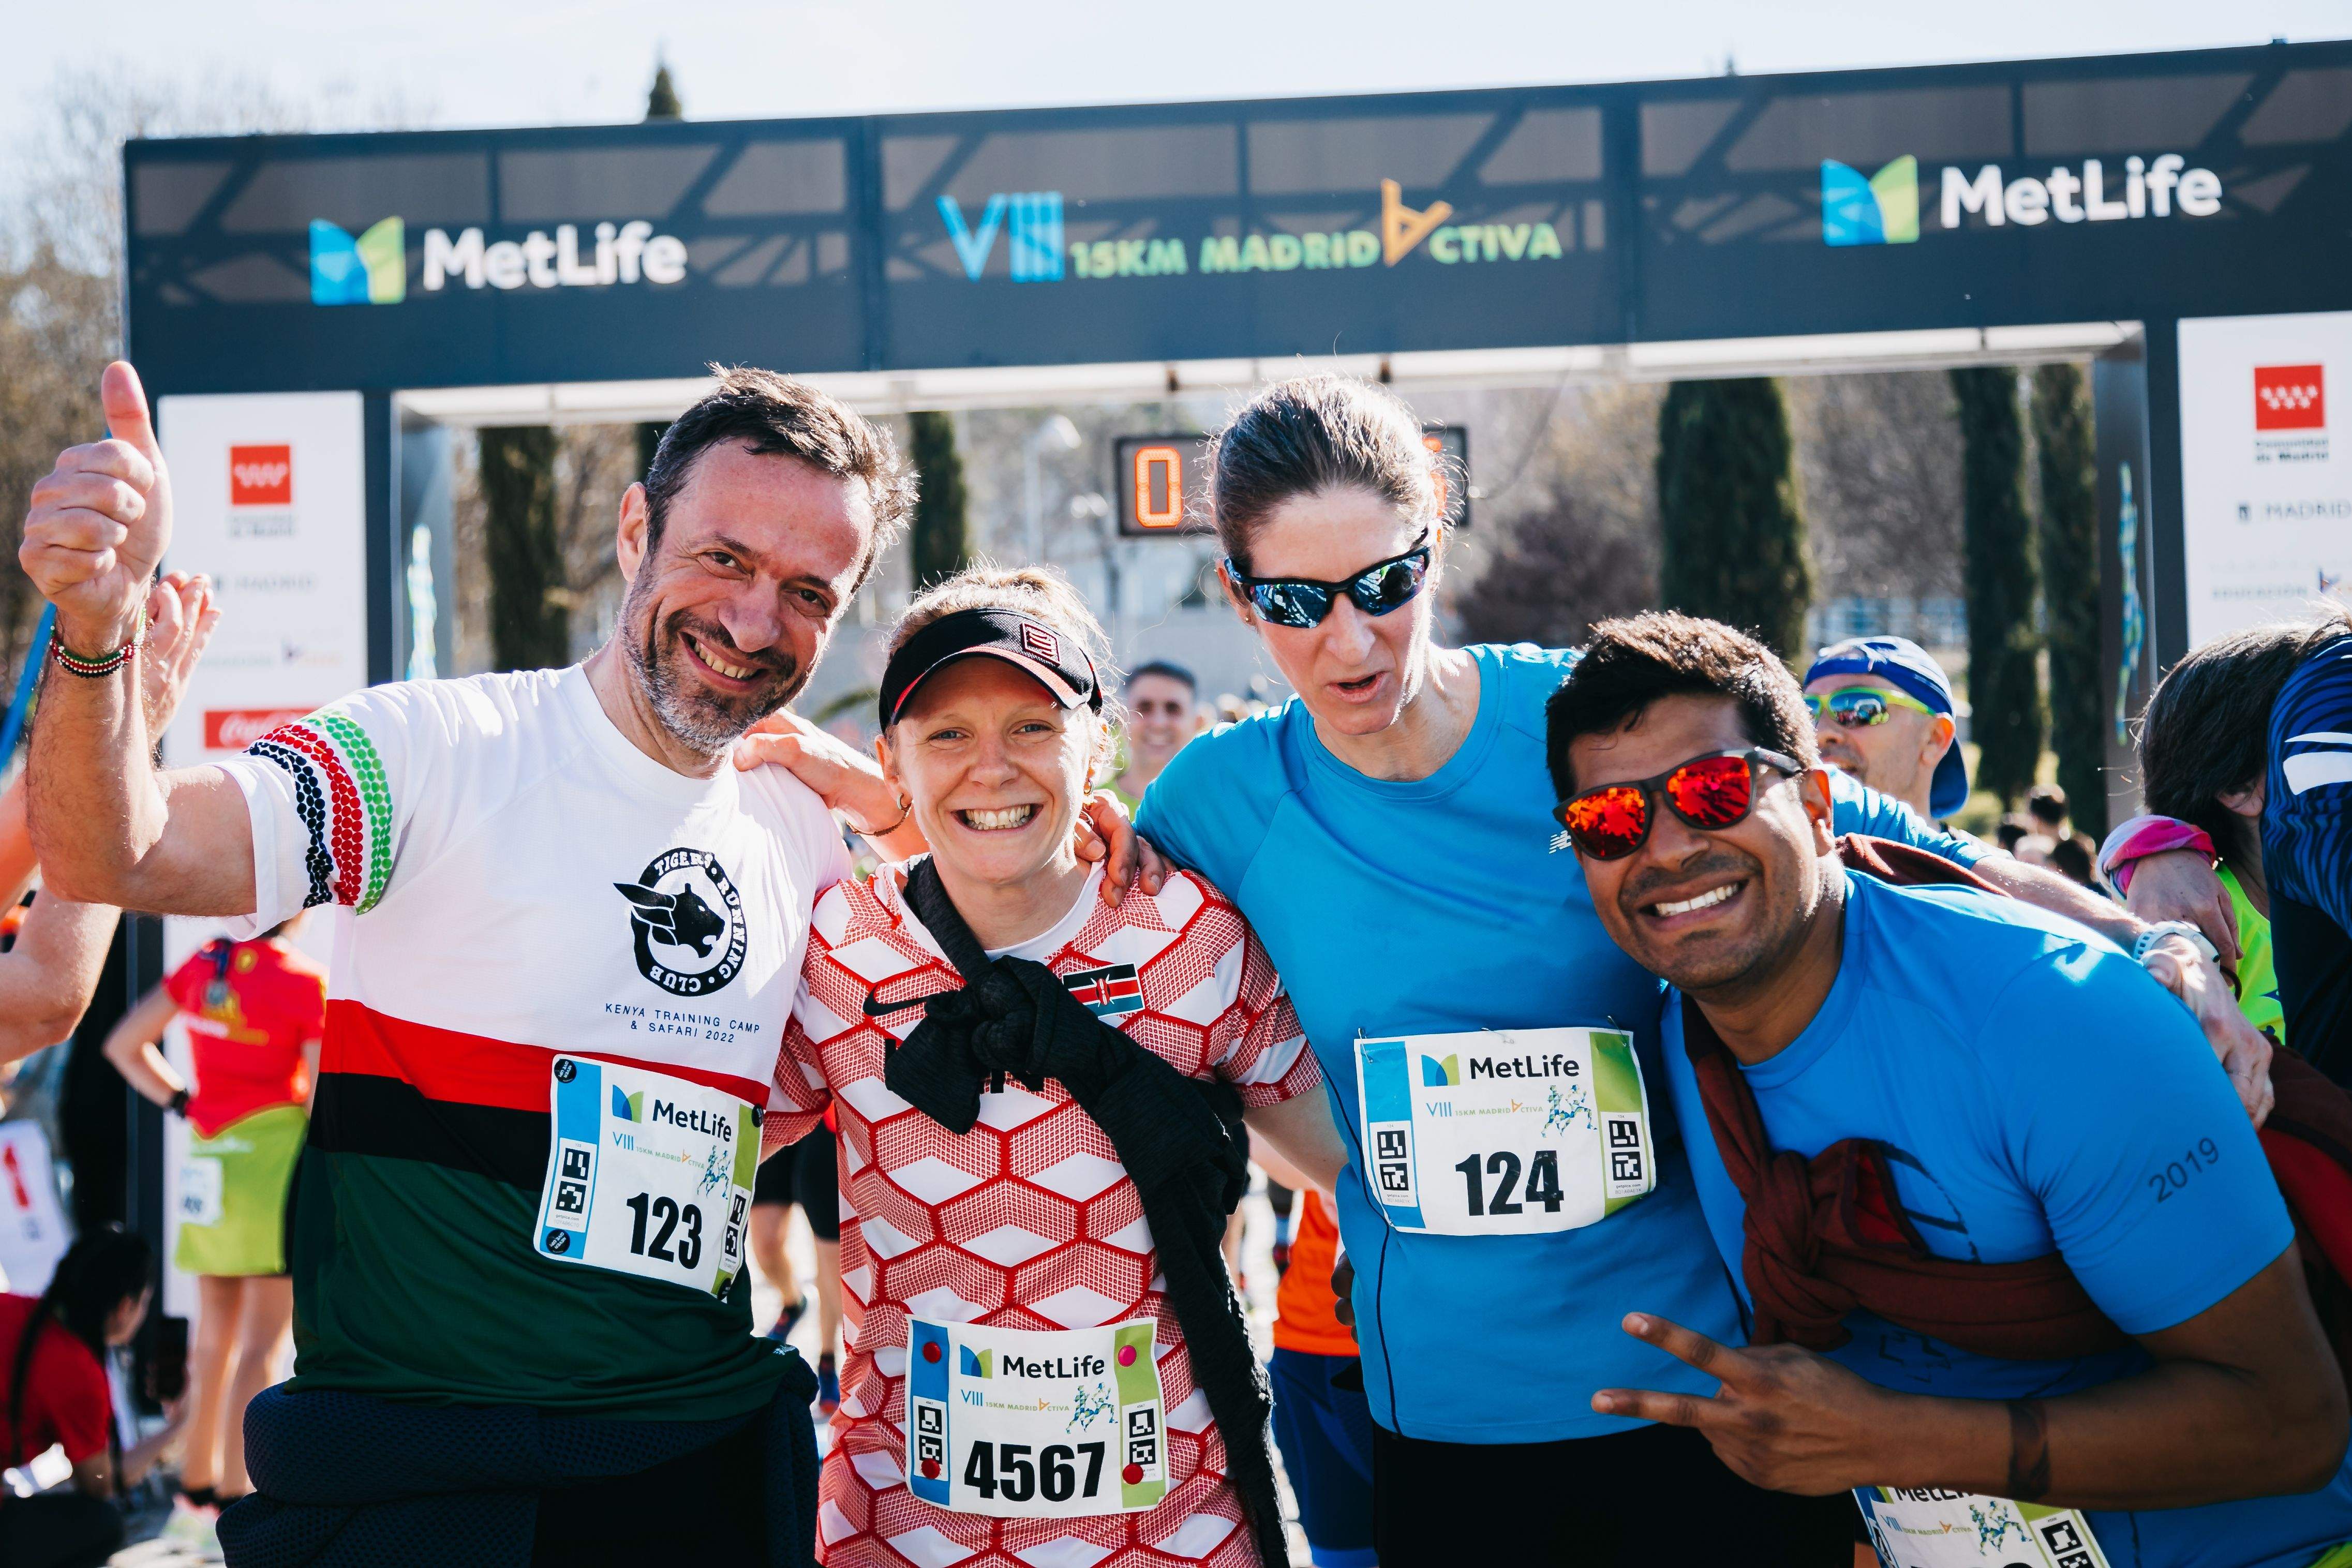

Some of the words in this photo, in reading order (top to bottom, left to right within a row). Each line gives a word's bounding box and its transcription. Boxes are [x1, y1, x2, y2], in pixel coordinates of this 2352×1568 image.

[1940, 154, 2222, 229] MetLife
[422, 220, 688, 291] MetLife
[1069, 239, 1187, 279] 15KM
[1200, 230, 1380, 275] MADRID
[1135, 446, 1183, 528] 0
[654, 851, 713, 876] TIGERS
[717, 877, 746, 980] RUNNING
[650, 965, 702, 992] CLUB
[605, 1003, 645, 1018] KENYA
[655, 1010, 721, 1027] TRAINING
[730, 1020, 761, 1034] CAMP
[630, 1021, 638, 1029] &
[649, 1022, 698, 1037] SAFARI
[705, 1030, 735, 1043] 2022
[1470, 1054, 1580, 1080] MetLife
[652, 1099, 732, 1142] MetLife
[1426, 1101, 1453, 1117] VIII
[613, 1131, 634, 1151] VIII
[636, 1146, 653, 1156] 15KM
[655, 1151, 681, 1162] MADRID
[1455, 1150, 1564, 1217] 124
[2149, 1138, 2219, 1203] 2019
[626, 1192, 703, 1270] 123
[1003, 1354, 1105, 1379] MetLife
[960, 1389, 983, 1407] VIII
[964, 1440, 1105, 1502] 4567
